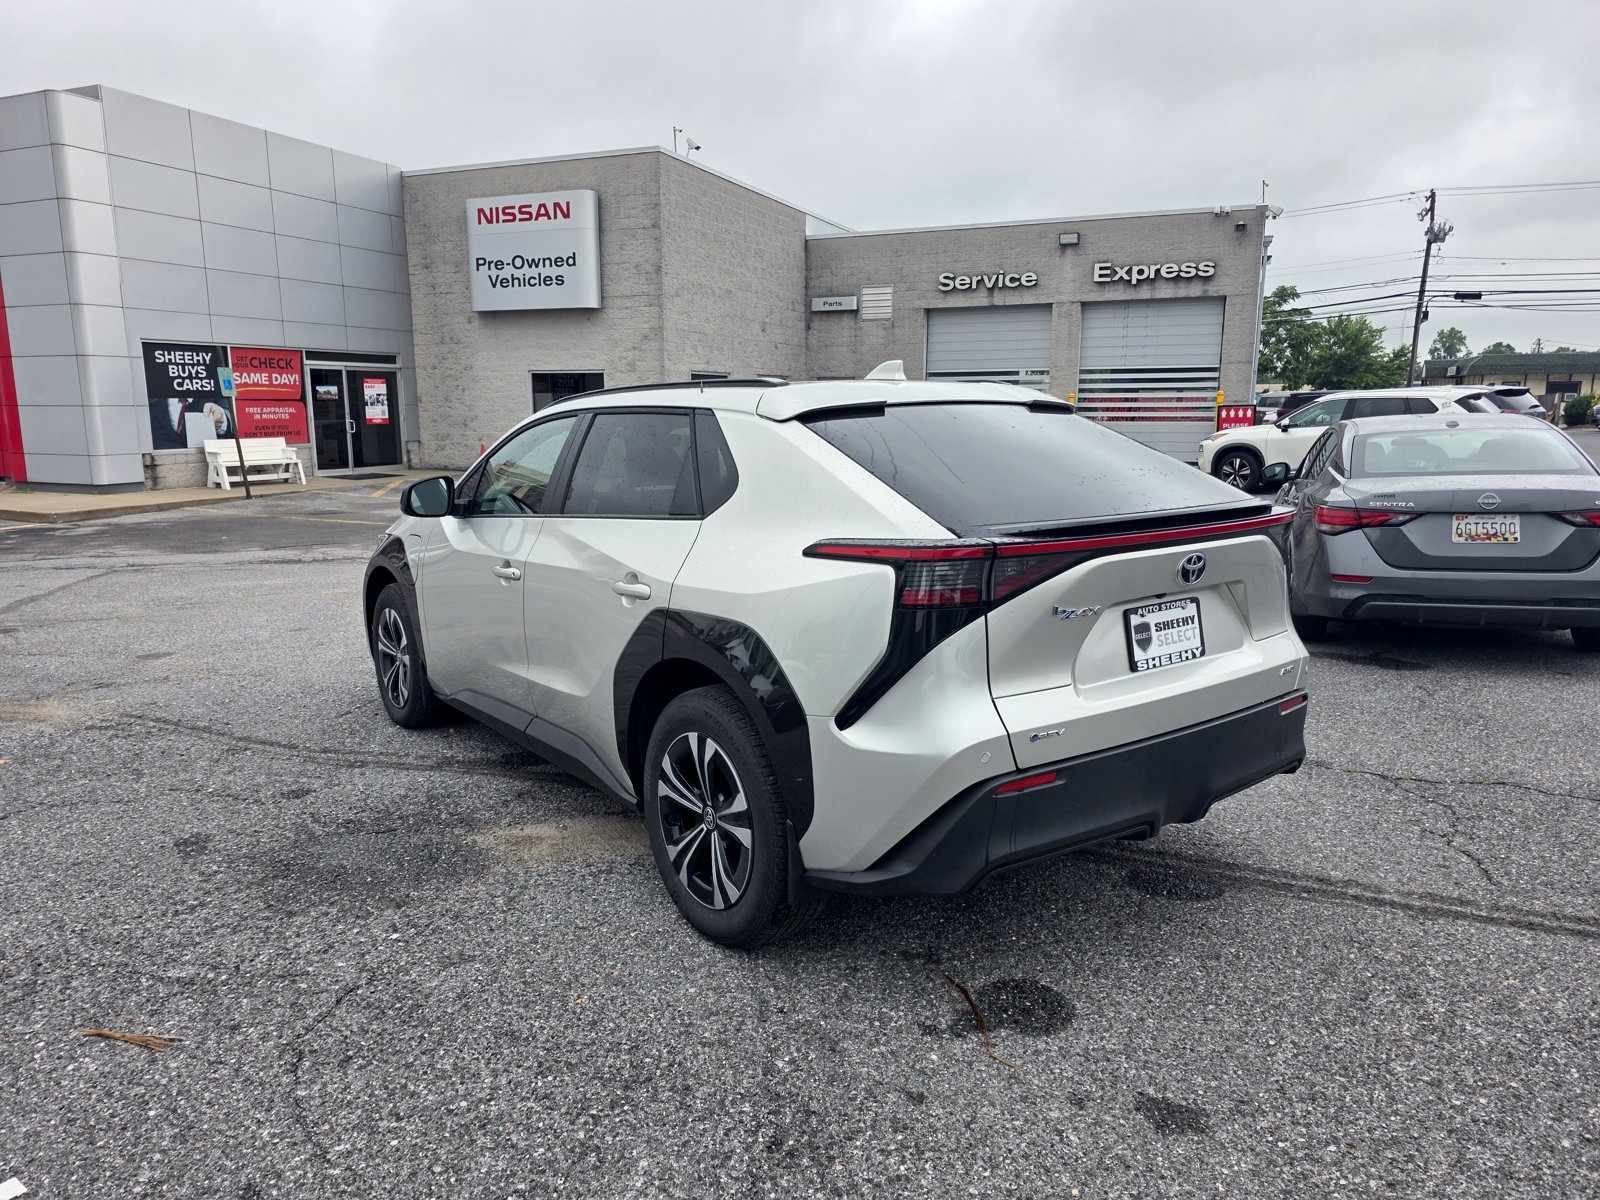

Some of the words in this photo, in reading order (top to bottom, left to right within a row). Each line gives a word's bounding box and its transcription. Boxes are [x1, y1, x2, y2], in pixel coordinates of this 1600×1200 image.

[477, 201, 571, 225] NISSAN
[475, 252, 577, 272] Pre-Owned
[938, 270, 1038, 291] Service
[1093, 261, 1216, 284] Express
[487, 273, 565, 289] Vehicles
[154, 350, 212, 364] SHEEHY
[249, 356, 294, 369] CHECK
[168, 365, 207, 378] BUYS
[233, 372, 269, 384] SAME
[272, 373, 300, 385] DAY!
[173, 379, 215, 391] CARS!
[1455, 522, 1516, 536] 6GT5500
[1137, 605, 1159, 615] AUTO
[1161, 599, 1191, 611] STORES
[1154, 615, 1196, 632] SHEEHY
[1134, 631, 1151, 640] SELECT
[1157, 626, 1197, 647] SELECT
[1136, 647, 1203, 671] SHEEHY
